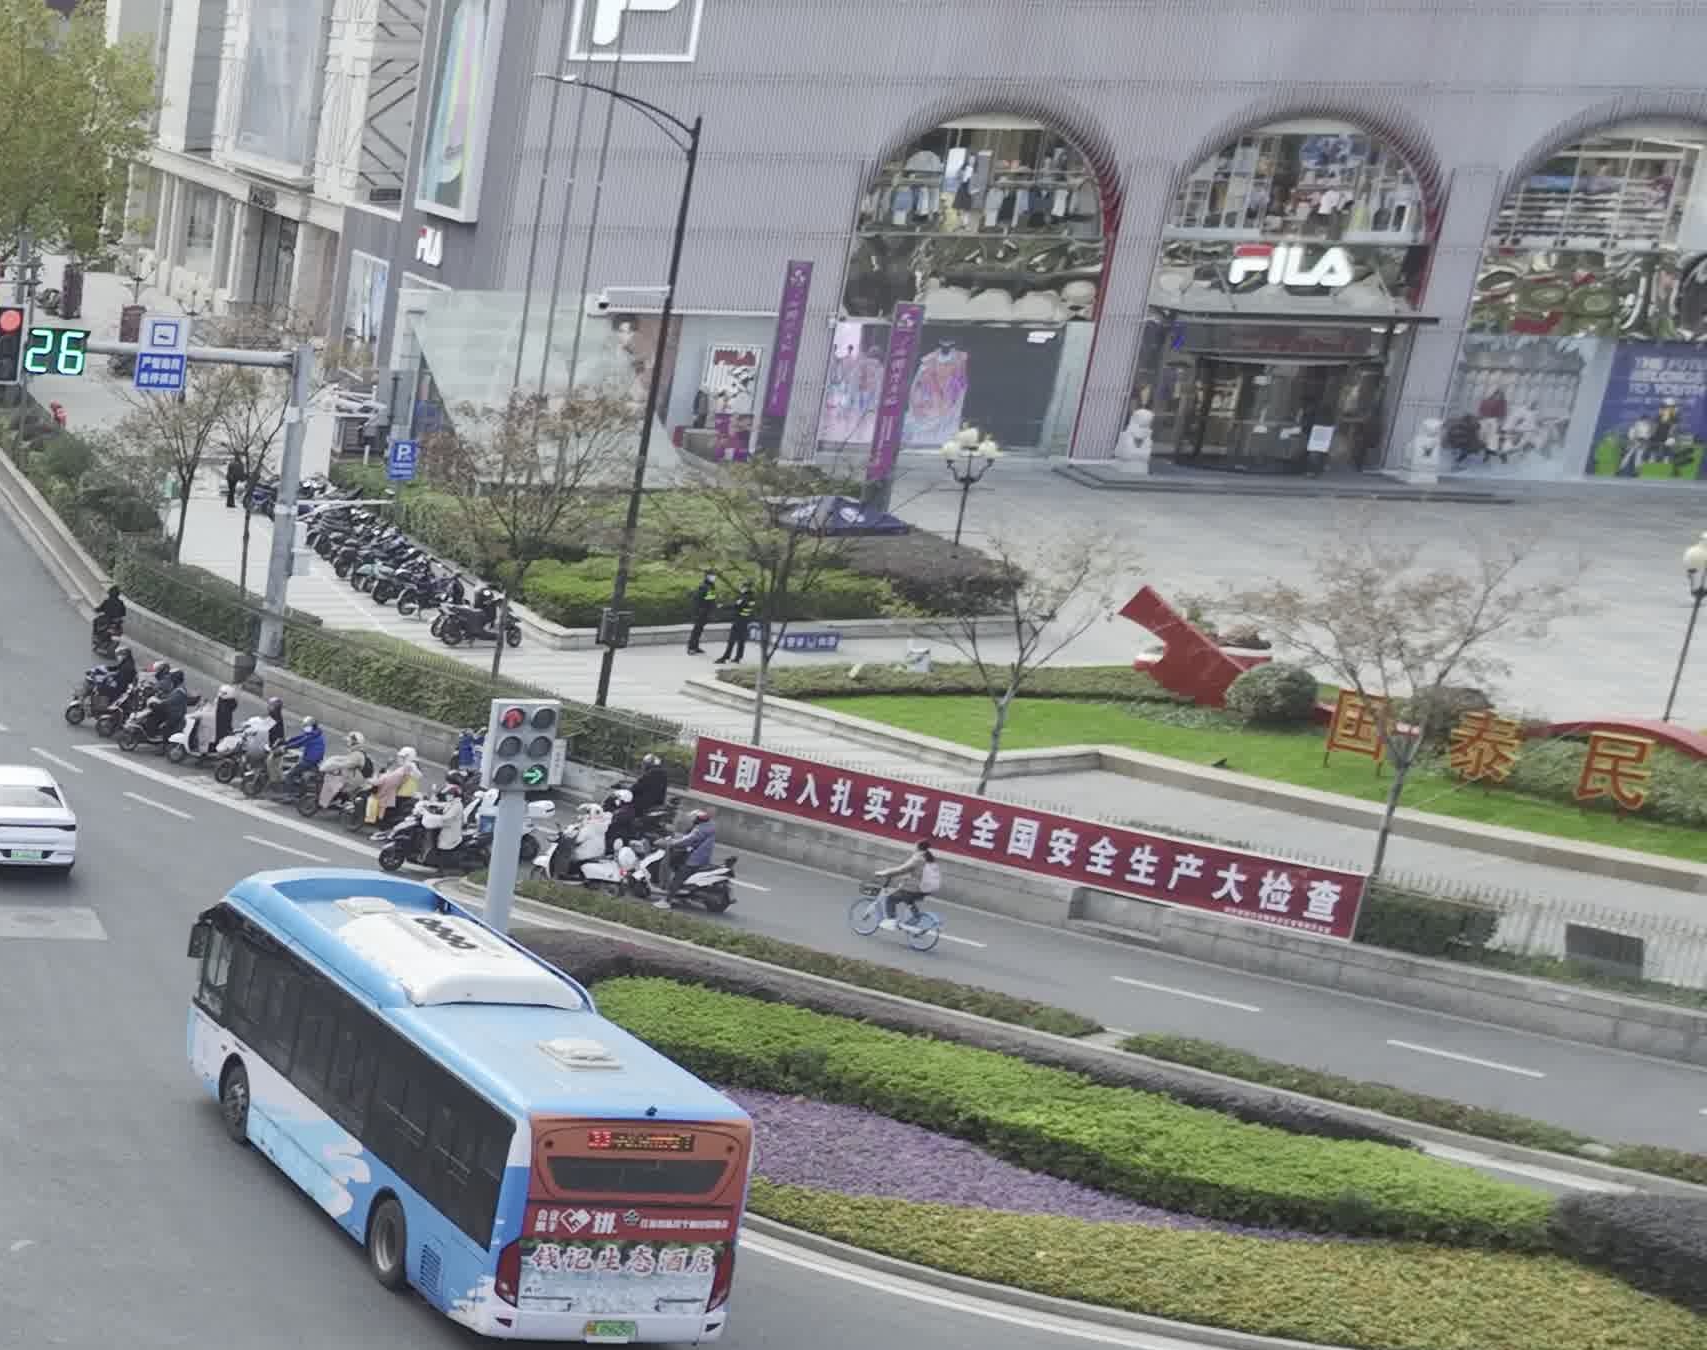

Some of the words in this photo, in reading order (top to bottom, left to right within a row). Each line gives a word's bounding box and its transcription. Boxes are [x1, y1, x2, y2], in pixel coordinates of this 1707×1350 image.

[1228, 241, 1353, 287] FILA
[24, 328, 86, 375] 26
[703, 749, 1343, 923] 立即深入扎实开展全国安全生产大检查
